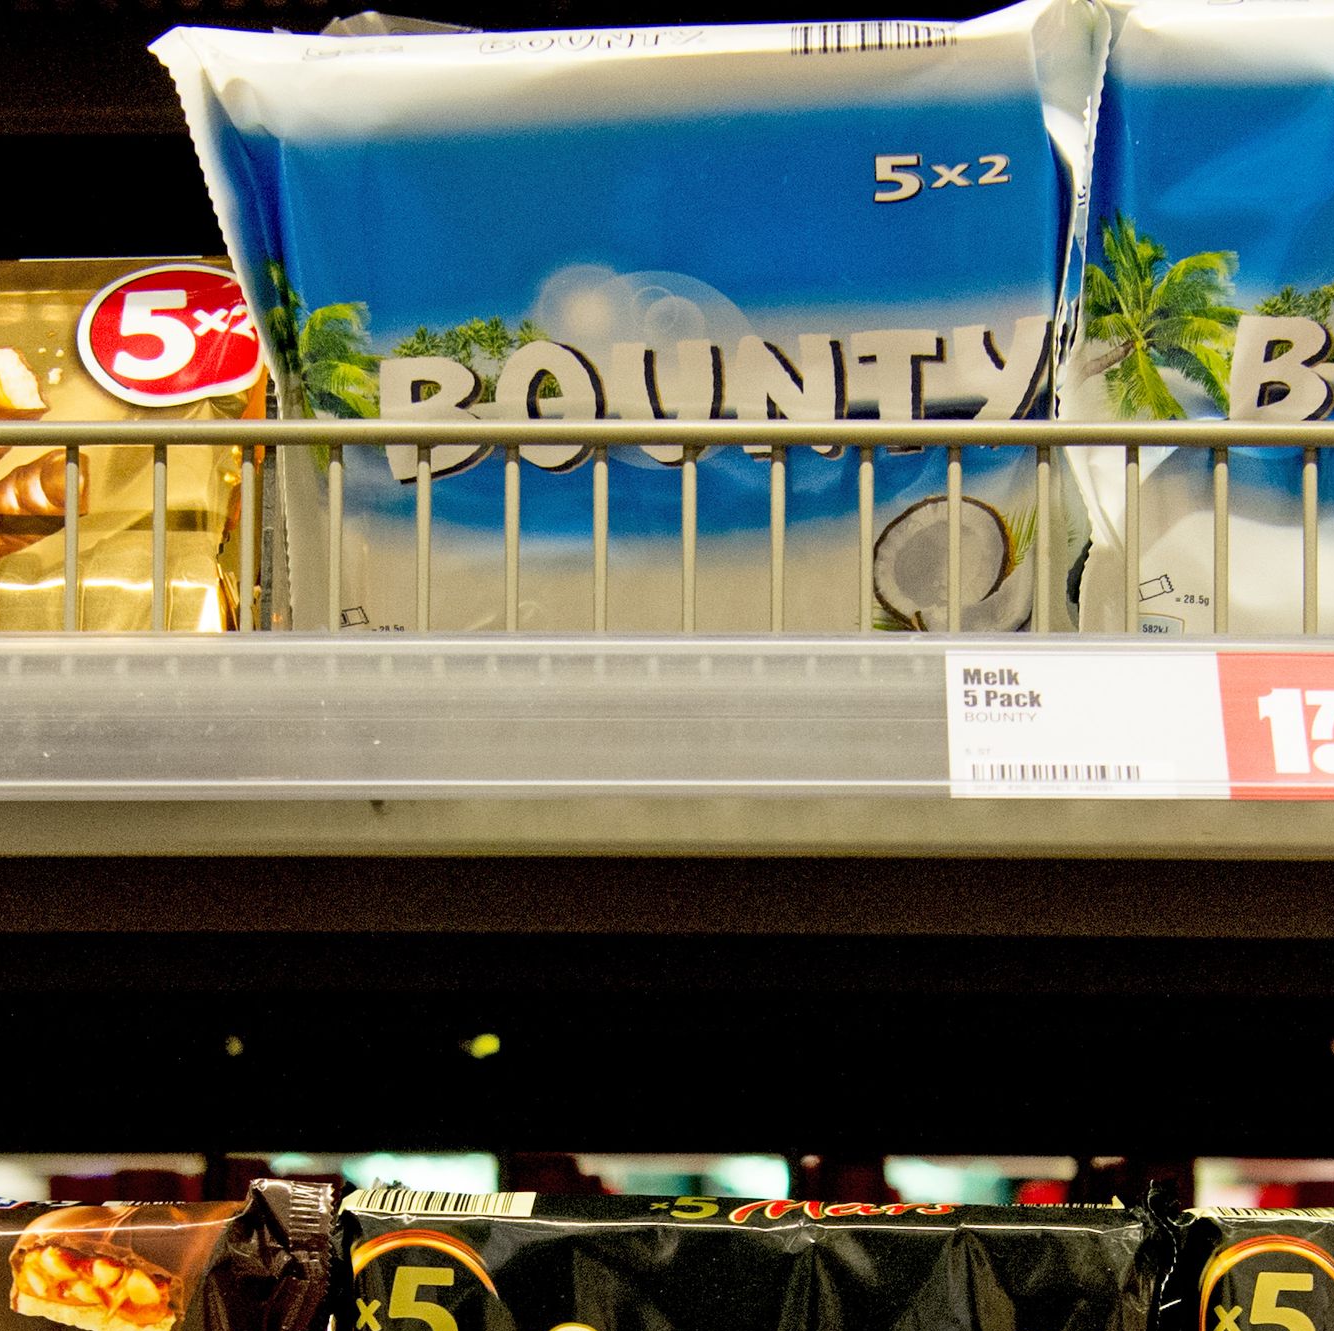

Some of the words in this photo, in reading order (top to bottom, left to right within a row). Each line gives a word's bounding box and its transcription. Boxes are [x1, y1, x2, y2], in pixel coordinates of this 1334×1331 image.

[873, 152, 1011, 203] 5x2
[379, 315, 1054, 484] BOUNTY
[1183, 594, 1210, 606] 28.5g
[963, 667, 1021, 686] Melk
[963, 689, 978, 708] 5
[985, 689, 1043, 708] Pack
[963, 711, 1038, 723] BOUNTY
